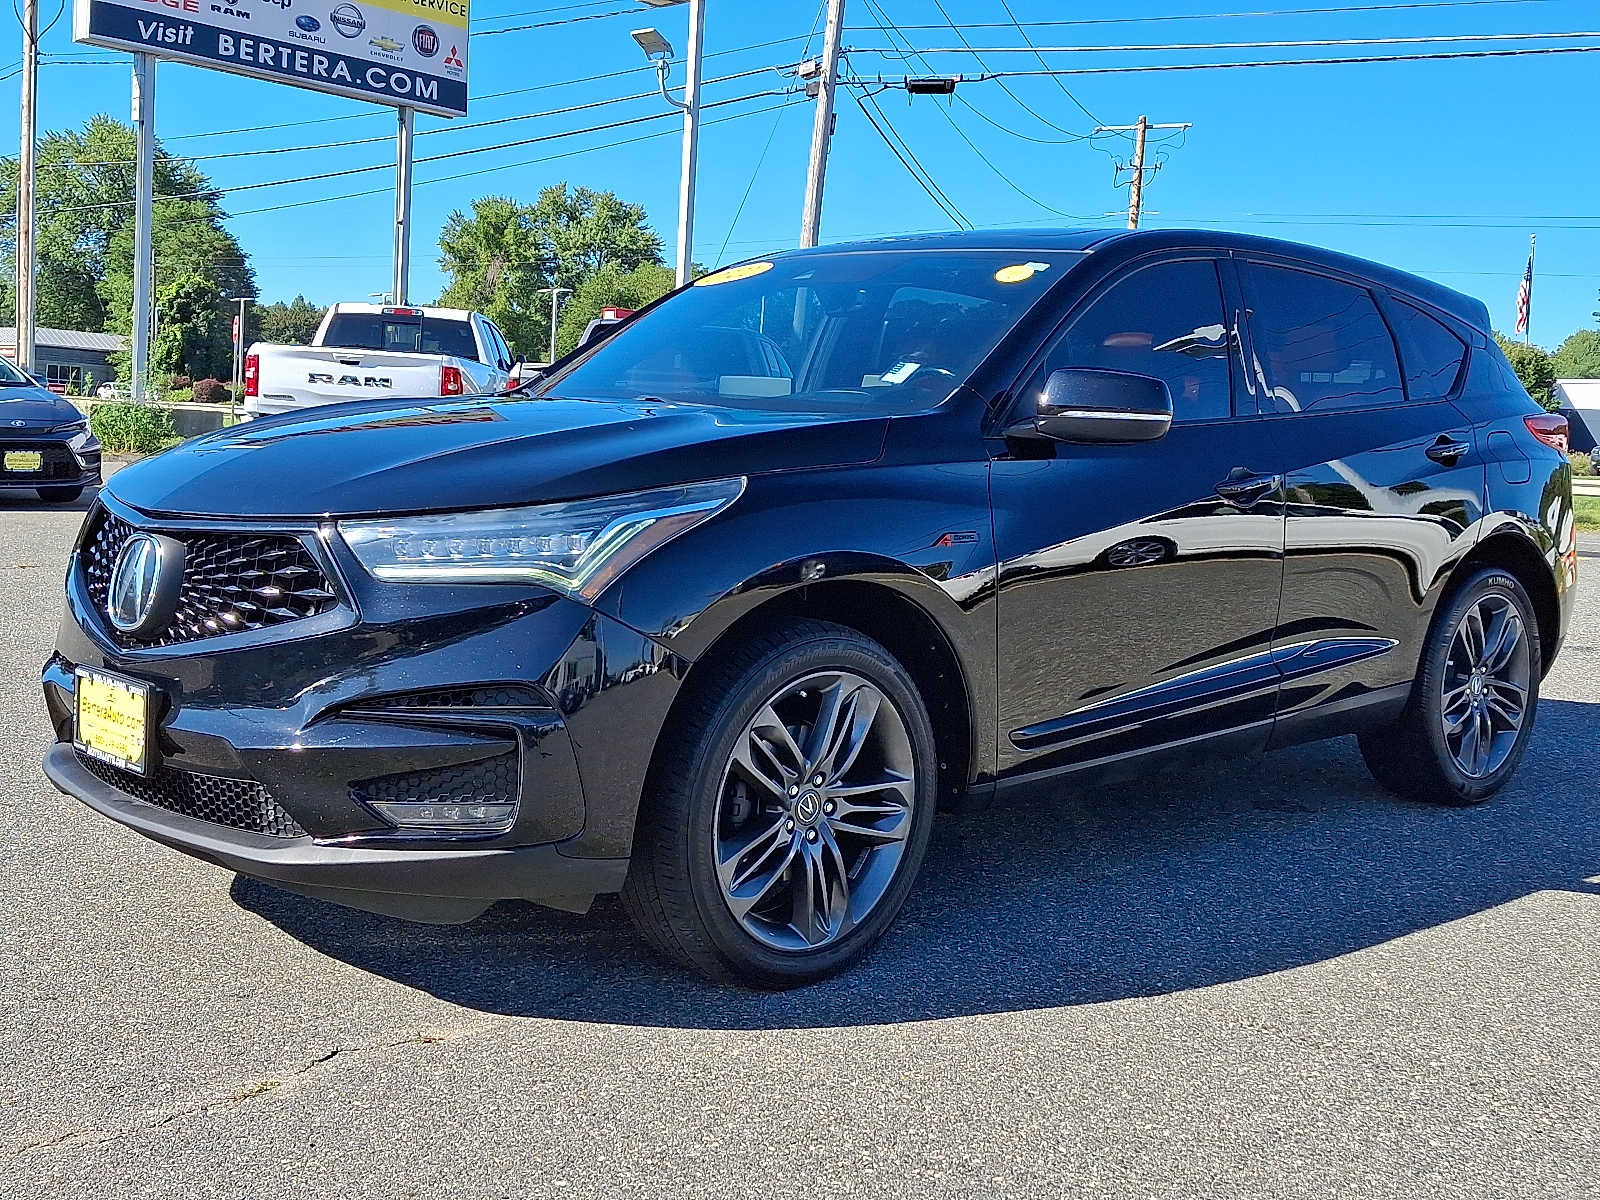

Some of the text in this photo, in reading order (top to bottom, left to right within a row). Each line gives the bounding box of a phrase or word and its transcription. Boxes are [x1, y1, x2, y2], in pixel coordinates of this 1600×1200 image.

[210, 4, 250, 19] RAM
[333, 14, 363, 28] NISSAN
[288, 30, 326, 44] SUBARU
[419, 33, 434, 50] FIAT
[137, 19, 438, 101] Visit BERTERA.COM
[370, 50, 403, 62] CHEVROLET
[308, 373, 392, 389] RAM
[1488, 576, 1515, 589] KUMHO
